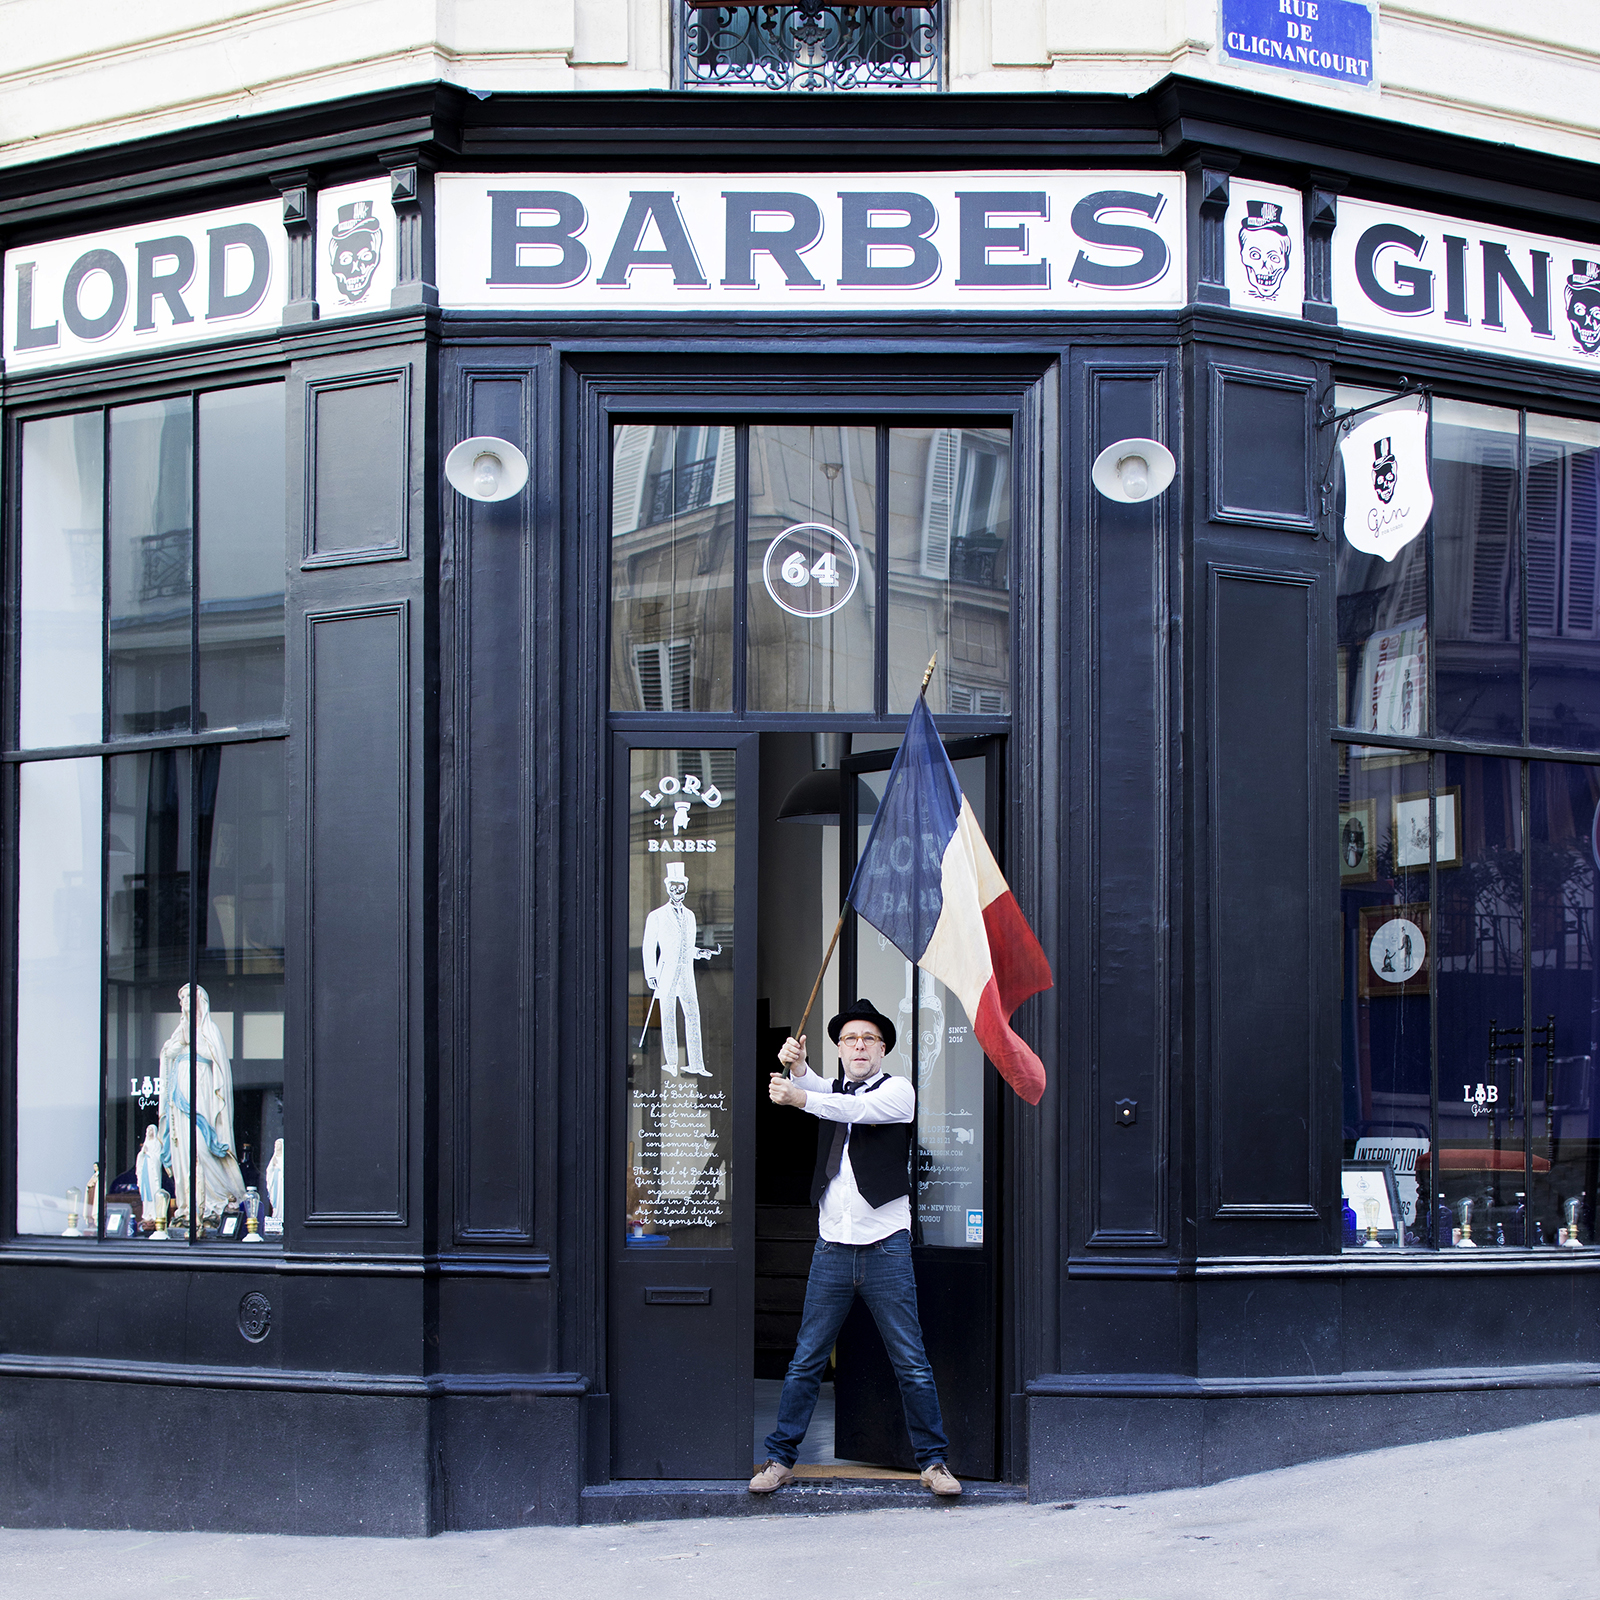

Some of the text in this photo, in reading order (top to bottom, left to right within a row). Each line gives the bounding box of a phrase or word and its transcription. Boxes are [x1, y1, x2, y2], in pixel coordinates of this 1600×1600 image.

[1279, 0, 1319, 21] RUE
[1286, 21, 1313, 42] DE
[1227, 31, 1369, 77] CLIGNANCOURT
[485, 189, 1171, 291] BARBES
[1355, 223, 1556, 340] GIN
[13, 222, 272, 355] LORD
[1367, 507, 1411, 538] Gin
[781, 551, 840, 588] 64
[640, 774, 722, 808] LORD
[647, 839, 717, 853] BARBES
[678, 1081, 698, 1091] gin
[633, 1089, 658, 1099] Lord
[659, 1090, 669, 1101] of
[709, 1091, 726, 1099] est
[138, 1096, 159, 1110] Gin
[650, 1101, 671, 1110] gin
[668, 1110, 679, 1118] et
[680, 1109, 708, 1118] made
[1470, 1103, 1492, 1117] Gin
[638, 1129, 674, 1138] Comme
[927, 1125, 950, 1133] LOPEZ
[632, 1166, 652, 1176] The
[652, 1166, 678, 1176] Lord
[678, 1166, 689, 1178] of
[634, 1176, 656, 1188] Gin
[647, 1186, 710, 1197] organic and
[639, 1196, 667, 1205] made
[663, 1206, 688, 1215] Lord
[690, 1206, 724, 1215] drink
[930, 1204, 945, 1212] NEW
[945, 1204, 961, 1212] YORK
[639, 1216, 651, 1225] it
